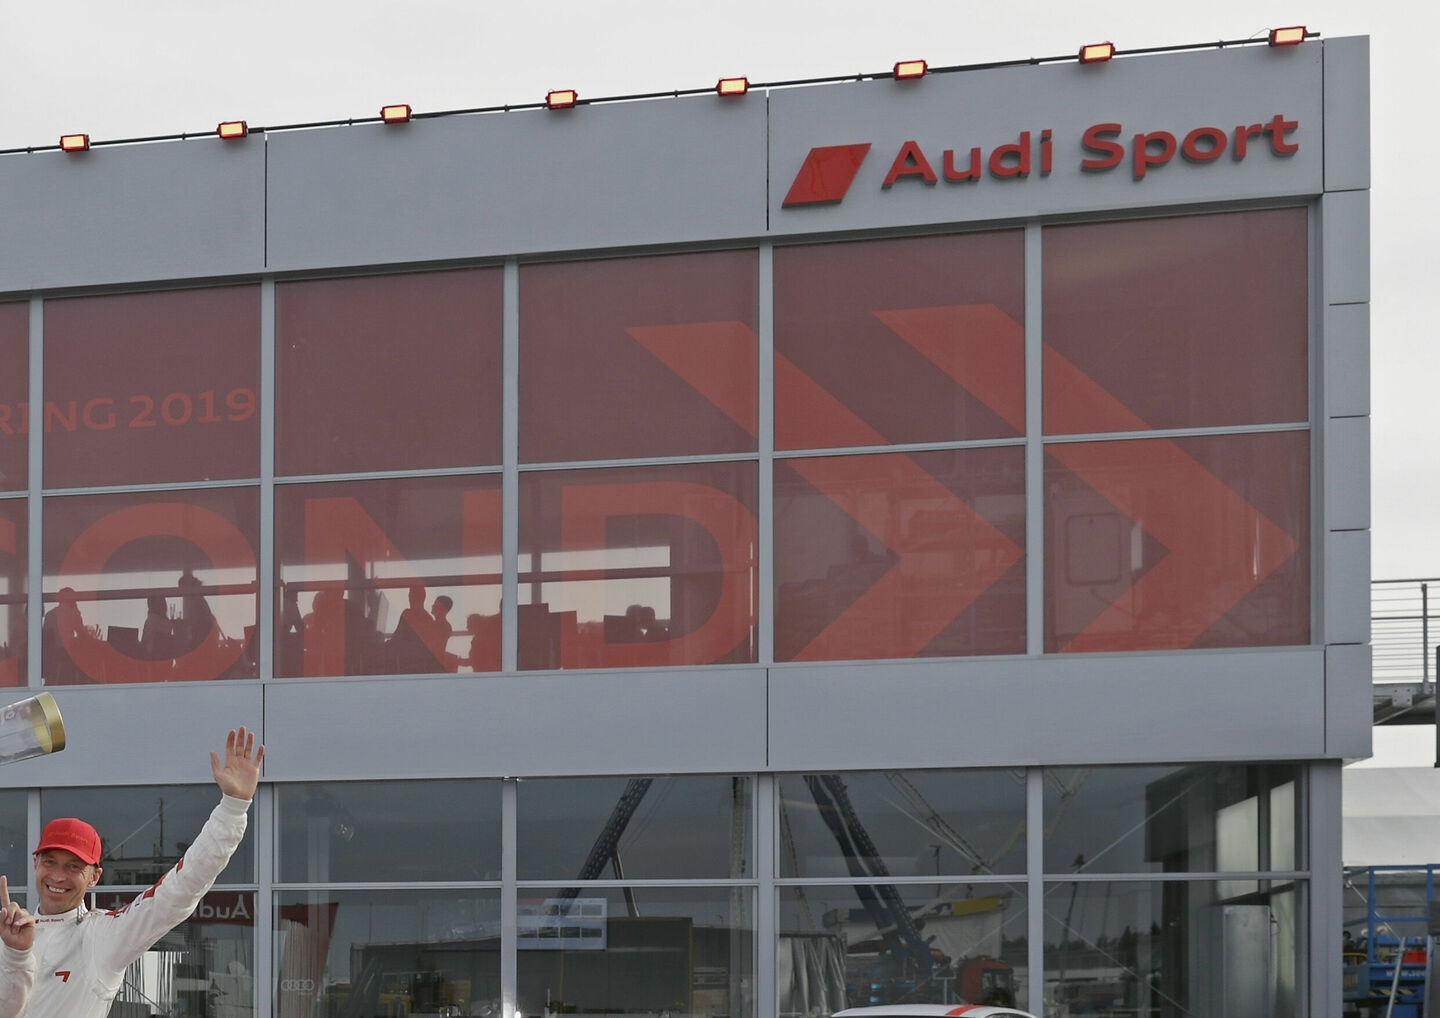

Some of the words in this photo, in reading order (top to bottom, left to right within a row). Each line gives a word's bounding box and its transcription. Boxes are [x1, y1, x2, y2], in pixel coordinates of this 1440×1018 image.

[882, 129, 1053, 189] Audi
[1082, 114, 1298, 180] Sport
[129, 388, 257, 427] 2019
